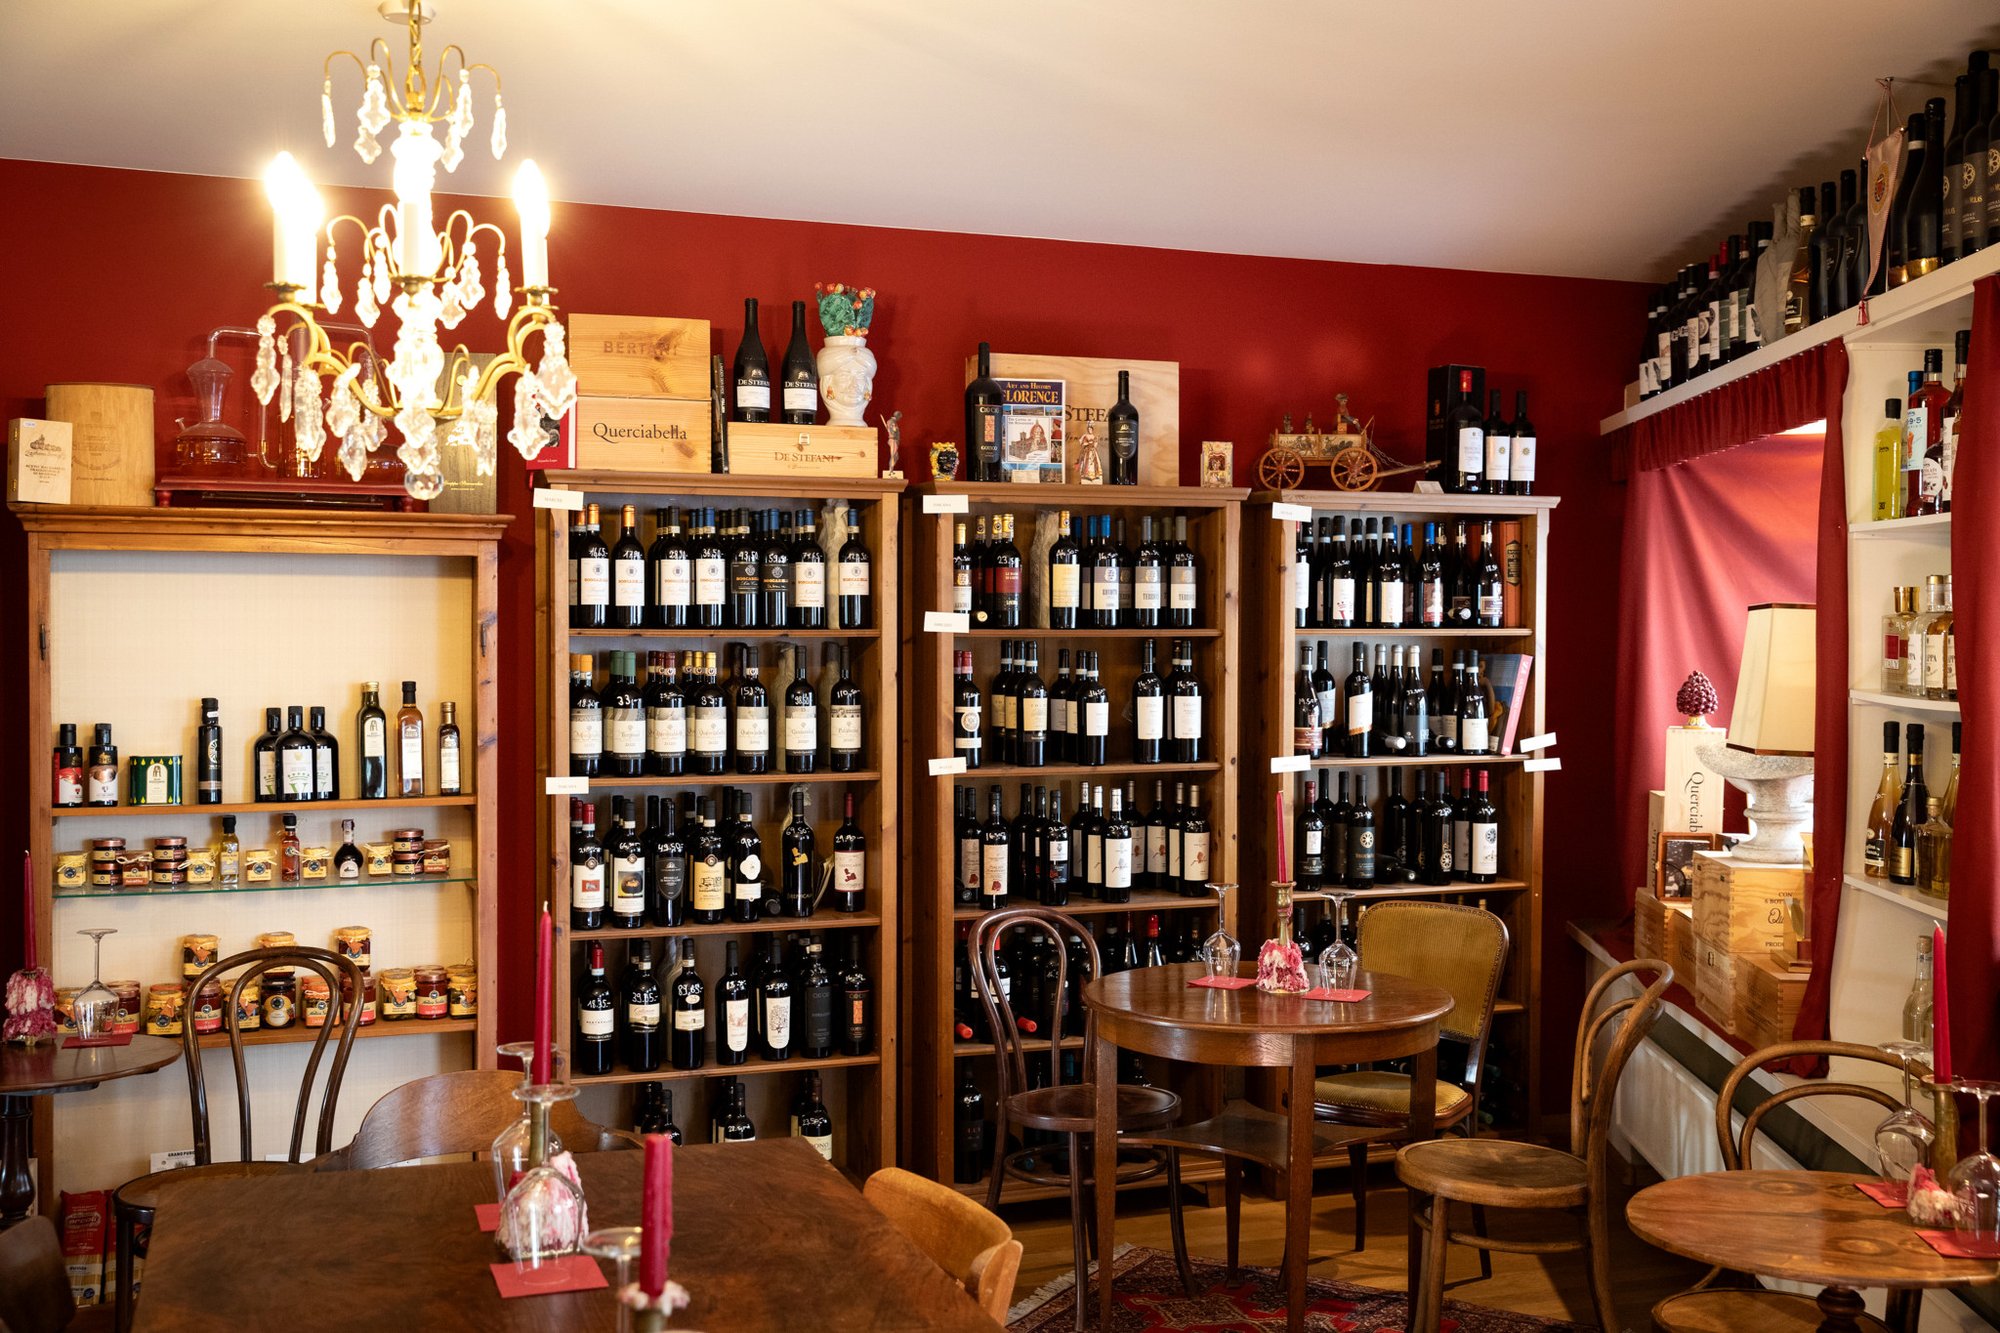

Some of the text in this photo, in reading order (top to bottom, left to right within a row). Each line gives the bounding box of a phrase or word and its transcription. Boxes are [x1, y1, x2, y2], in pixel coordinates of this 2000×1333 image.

[603, 340, 677, 356] BERTANI
[738, 378, 748, 386] DE
[593, 422, 688, 444] Querciabella
[774, 452, 835, 463] DE STEFANI
